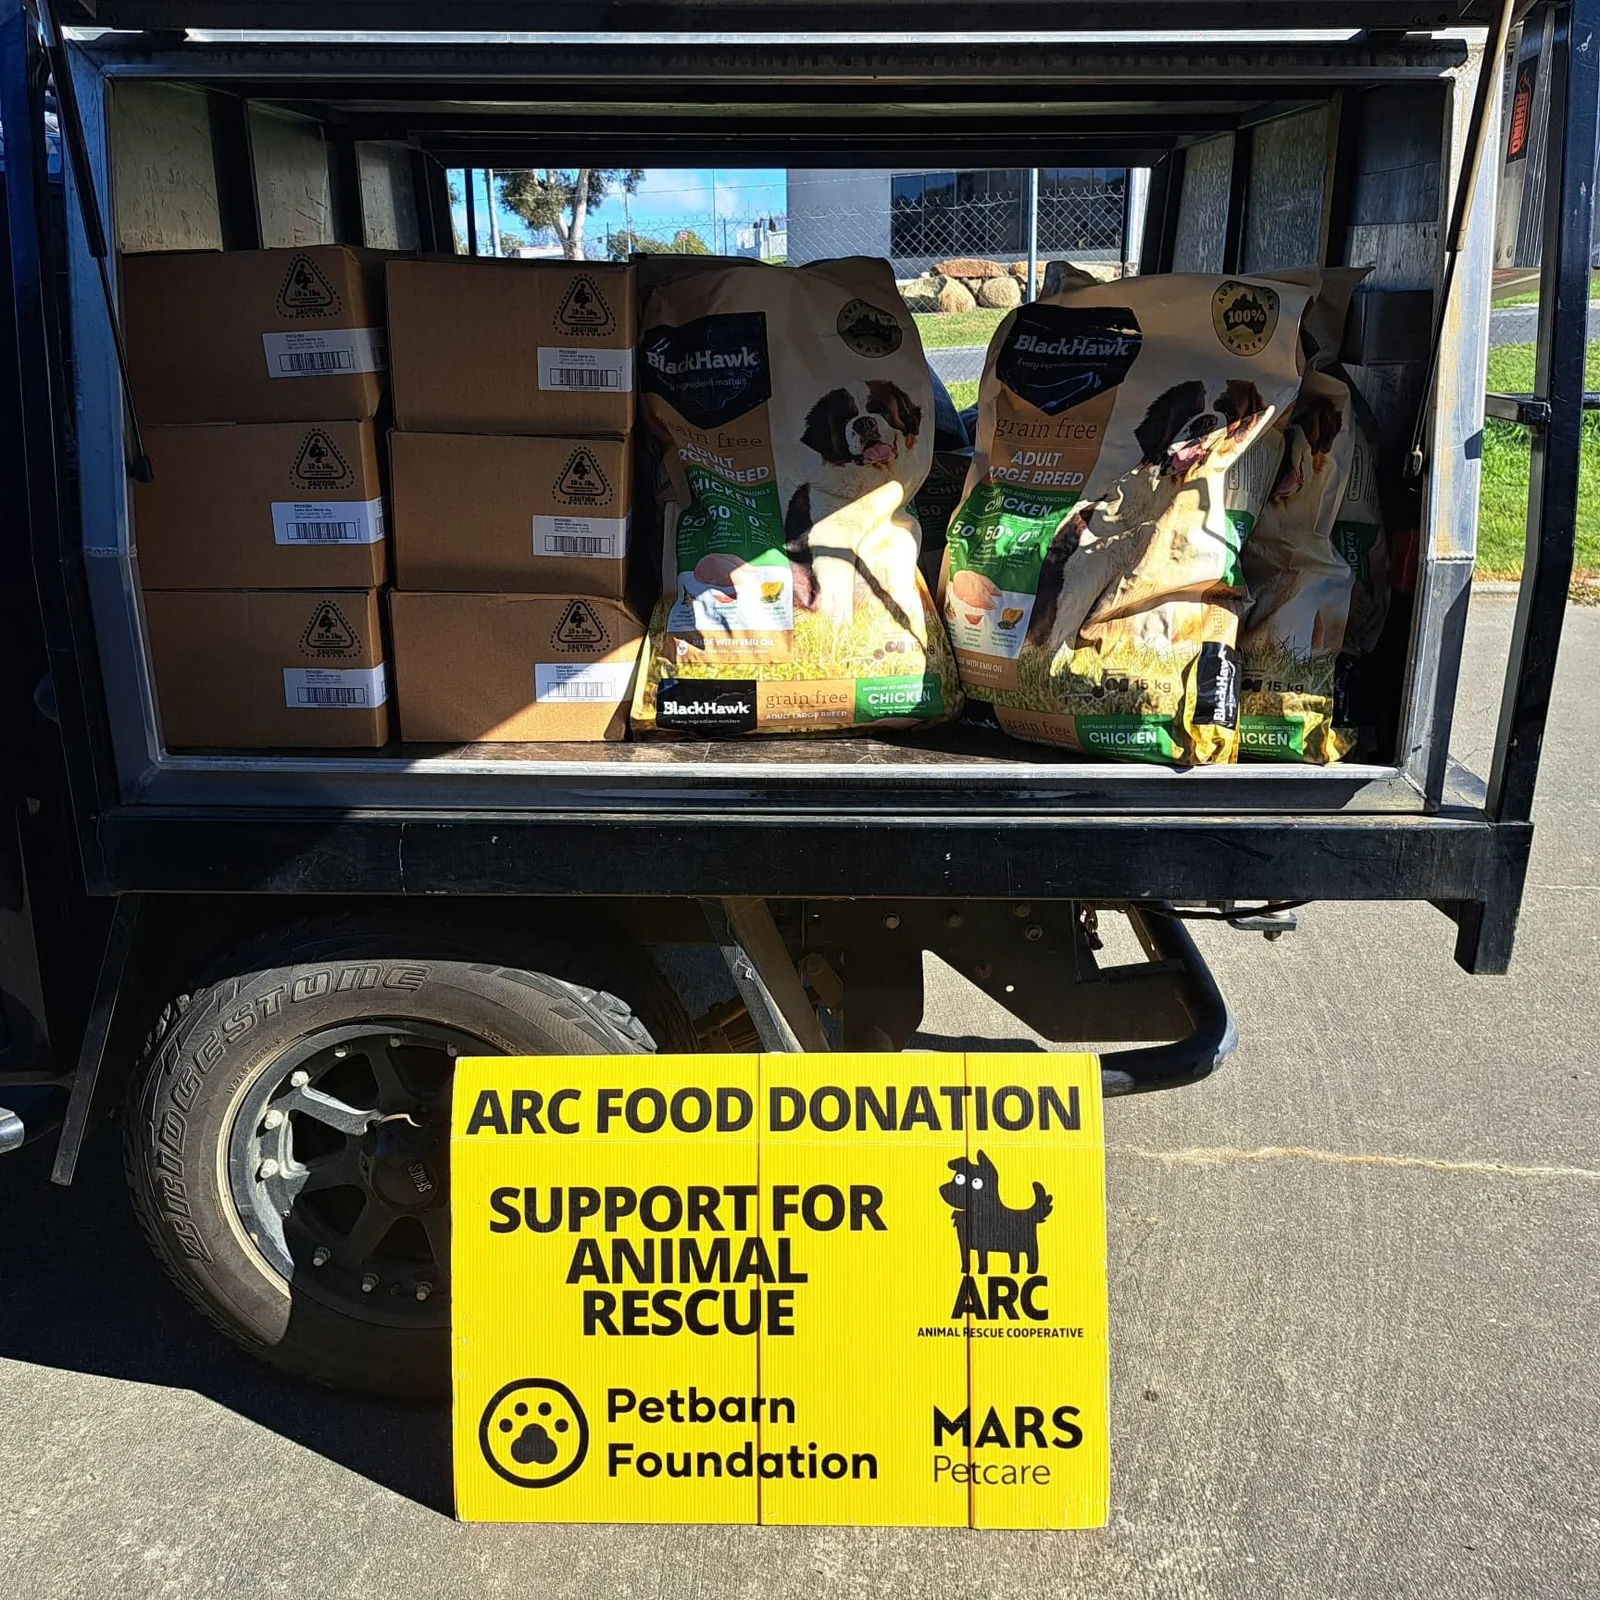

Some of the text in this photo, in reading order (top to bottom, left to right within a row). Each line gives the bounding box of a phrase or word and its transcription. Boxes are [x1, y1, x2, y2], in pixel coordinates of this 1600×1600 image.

[1228, 309, 1265, 324] 100%
[1013, 334, 1129, 356] BlackHawk
[646, 346, 758, 375] BlackHawk
[1016, 357, 1039, 370] Every
[994, 417, 1098, 440] grain free
[717, 432, 764, 448] free
[687, 442, 734, 469] ADULT
[1011, 450, 1063, 467] ADULT
[715, 466, 770, 482] BREED
[1031, 470, 1084, 486] BREED
[693, 478, 757, 509] HICKEN
[984, 525, 1014, 540] 50%
[979, 661, 992, 671] EMU
[1134, 678, 1171, 693] 15 kg
[1267, 681, 1304, 695] 15 kg
[765, 691, 848, 709] grain free
[868, 691, 931, 704] CHICKEN
[663, 700, 750, 715] BlackHawk
[766, 712, 789, 720] ADULT
[1004, 718, 1040, 734] grain
[1043, 719, 1072, 737] free
[1089, 731, 1157, 745] CHICKEN
[157, 963, 432, 1263] BRIDGESTONE
[466, 1086, 1081, 1134] ARC FOOD DONATION
[408, 1162, 432, 1193] SERIES
[489, 1184, 888, 1233] SUPPORT FOR
[565, 1237, 808, 1283] ANIMAL
[951, 1276, 1049, 1320] ARC
[583, 1289, 795, 1336] RESCUE
[917, 1327, 1084, 1338] ANIMAL RESCUE COOPERATIVE
[607, 1387, 795, 1424] Petbarn
[933, 1405, 1083, 1449] MARS
[608, 1442, 878, 1480] Foundation
[934, 1455, 1051, 1485] Petcare
